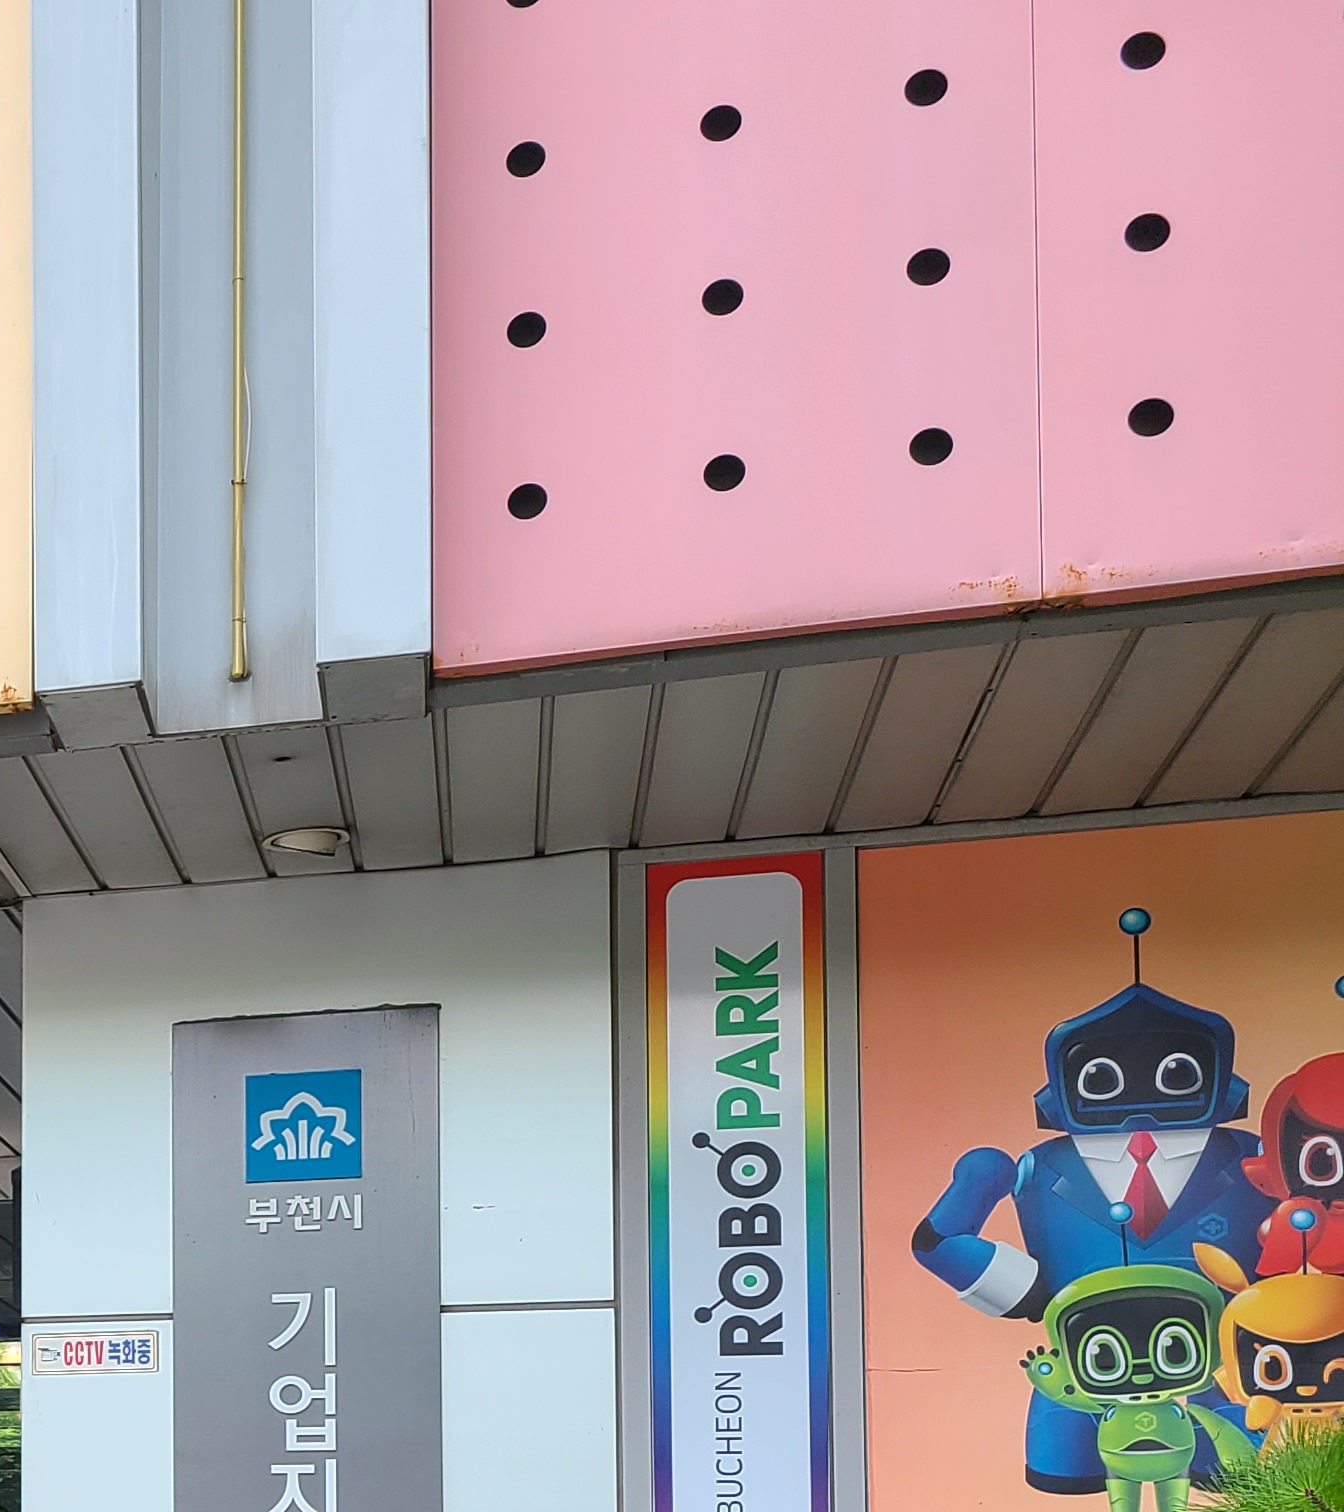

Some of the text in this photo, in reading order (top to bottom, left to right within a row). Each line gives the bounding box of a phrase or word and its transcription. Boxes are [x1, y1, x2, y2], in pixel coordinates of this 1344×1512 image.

[244, 1193, 363, 1233] 부천시
[64, 1339, 151, 1366] CCTV 녹화중
